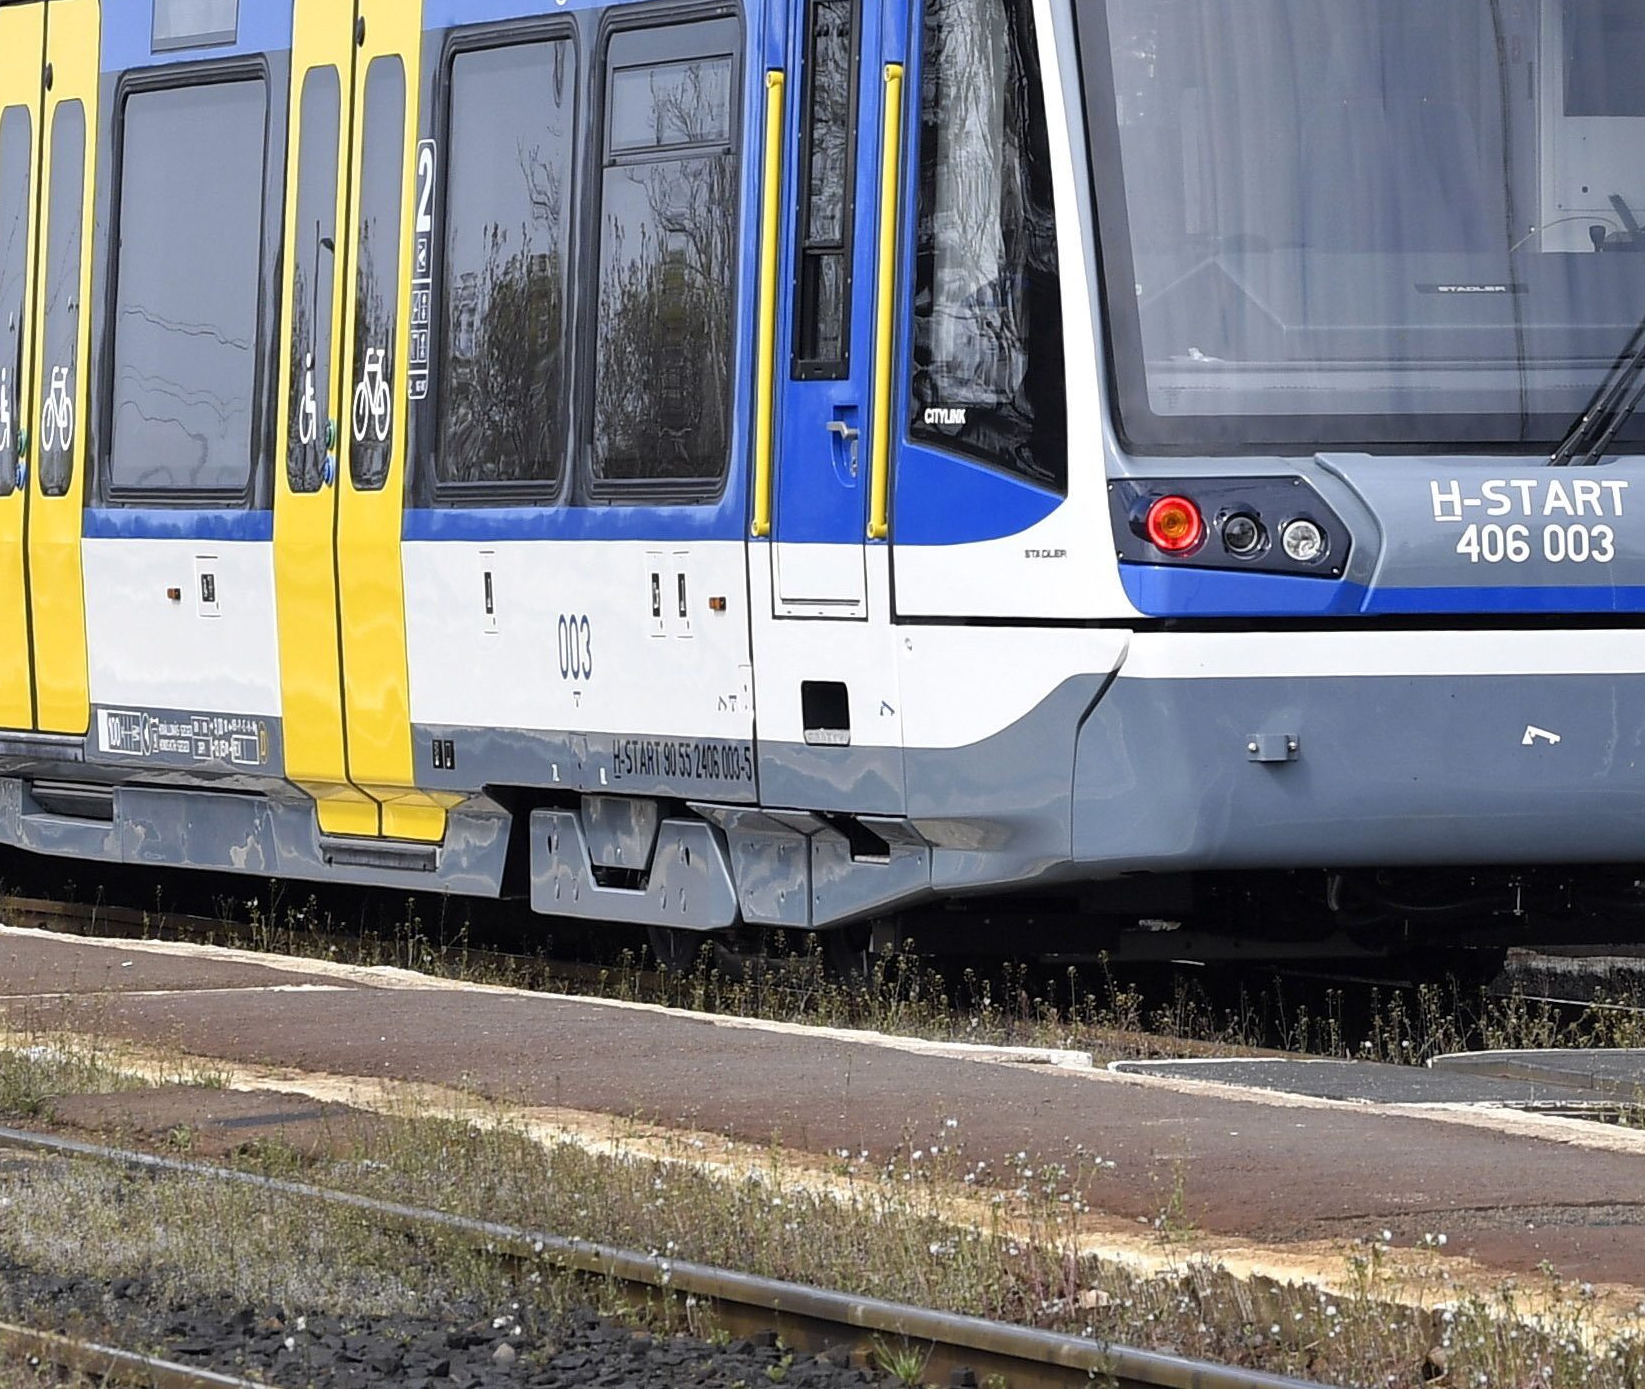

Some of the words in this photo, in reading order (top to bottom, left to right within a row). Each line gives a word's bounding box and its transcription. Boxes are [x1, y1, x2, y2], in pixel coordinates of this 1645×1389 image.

[415, 147, 433, 233] 2
[1437, 285, 1506, 293] STADLER
[924, 407, 967, 425] CITYLINK
[1431, 479, 1629, 521] H-START
[1024, 549, 1067, 559] STADLER
[1456, 524, 1536, 564] 406
[1542, 524, 1615, 564] 003
[558, 613, 592, 681] 003
[613, 739, 661, 779] H-START
[663, 743, 676, 777] 90
[679, 743, 692, 778] 55
[694, 744, 719, 780] 2406
[721, 745, 752, 782] 003-5
